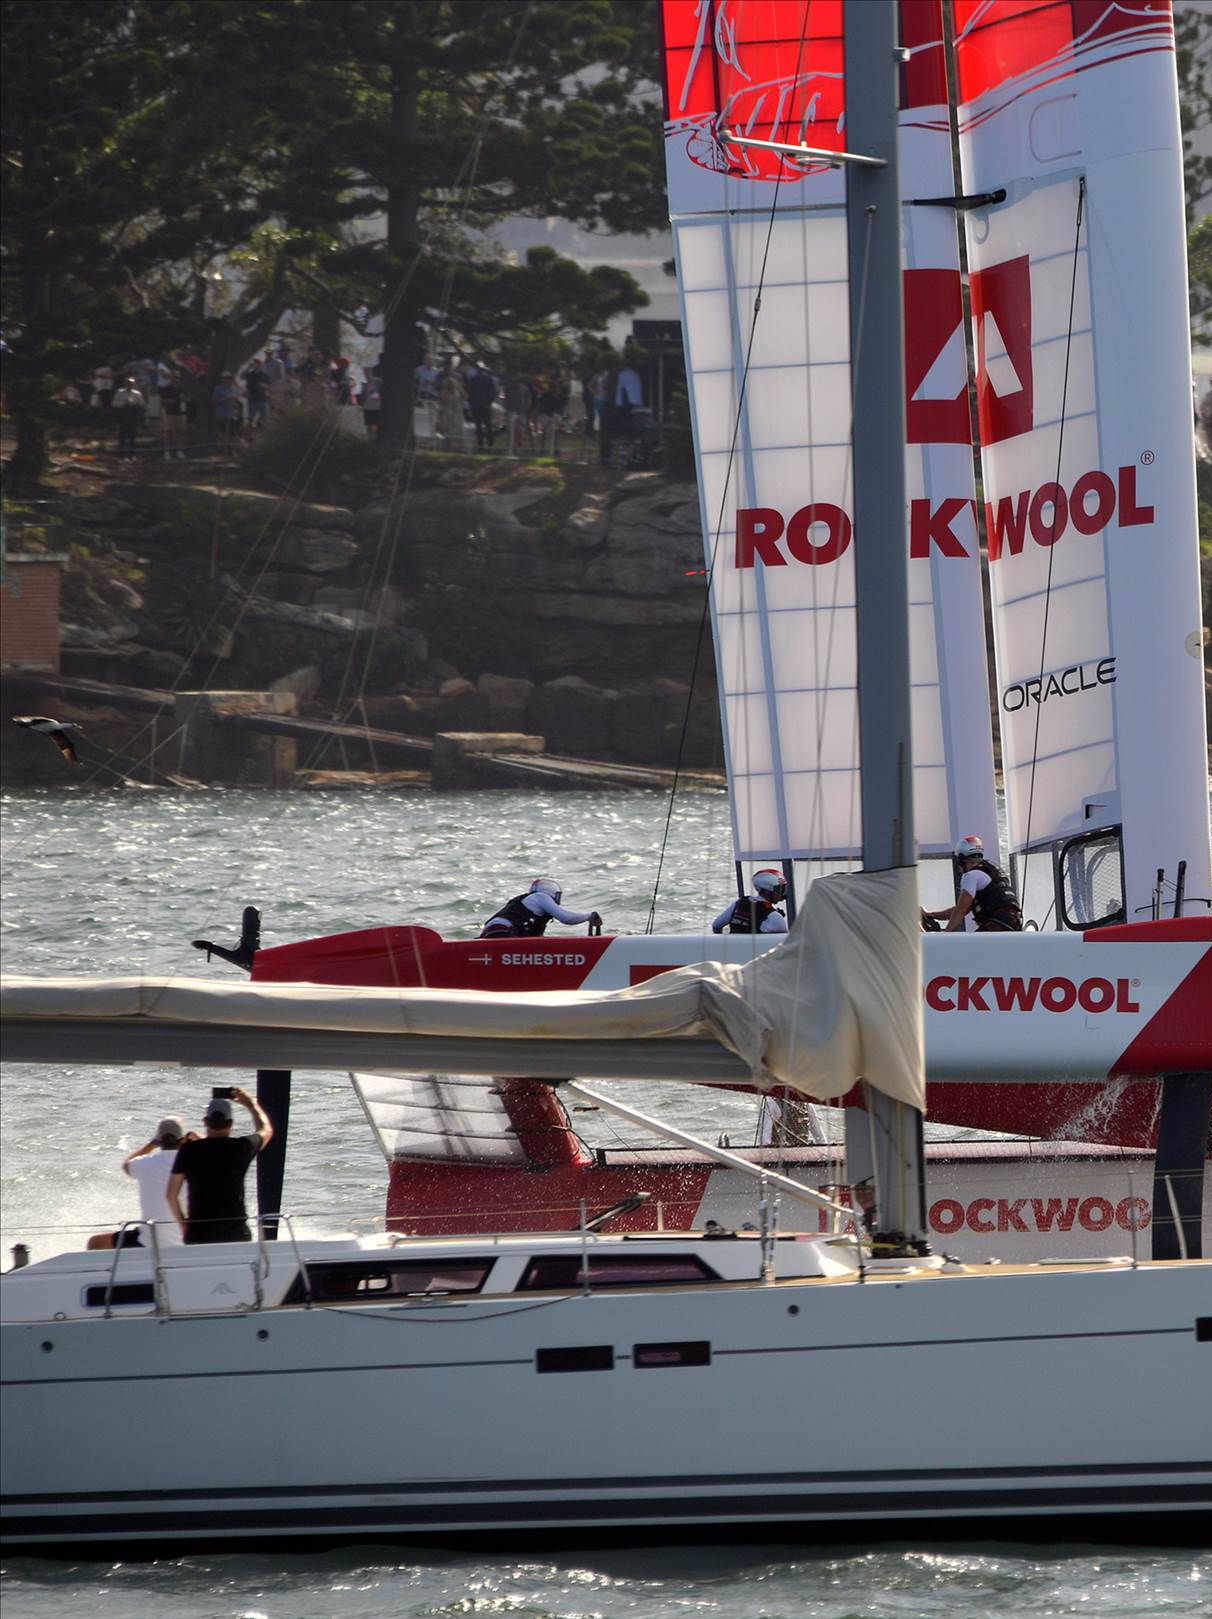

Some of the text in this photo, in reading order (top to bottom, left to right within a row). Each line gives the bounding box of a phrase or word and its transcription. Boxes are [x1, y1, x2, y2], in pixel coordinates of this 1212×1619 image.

[735, 465, 1154, 568] ROKWOOL
[1003, 657, 1117, 712] ORACLE
[502, 953, 586, 965] SEHESTED
[923, 976, 1139, 1013] CKWOOL
[928, 1196, 1152, 1234] OCKWOO
